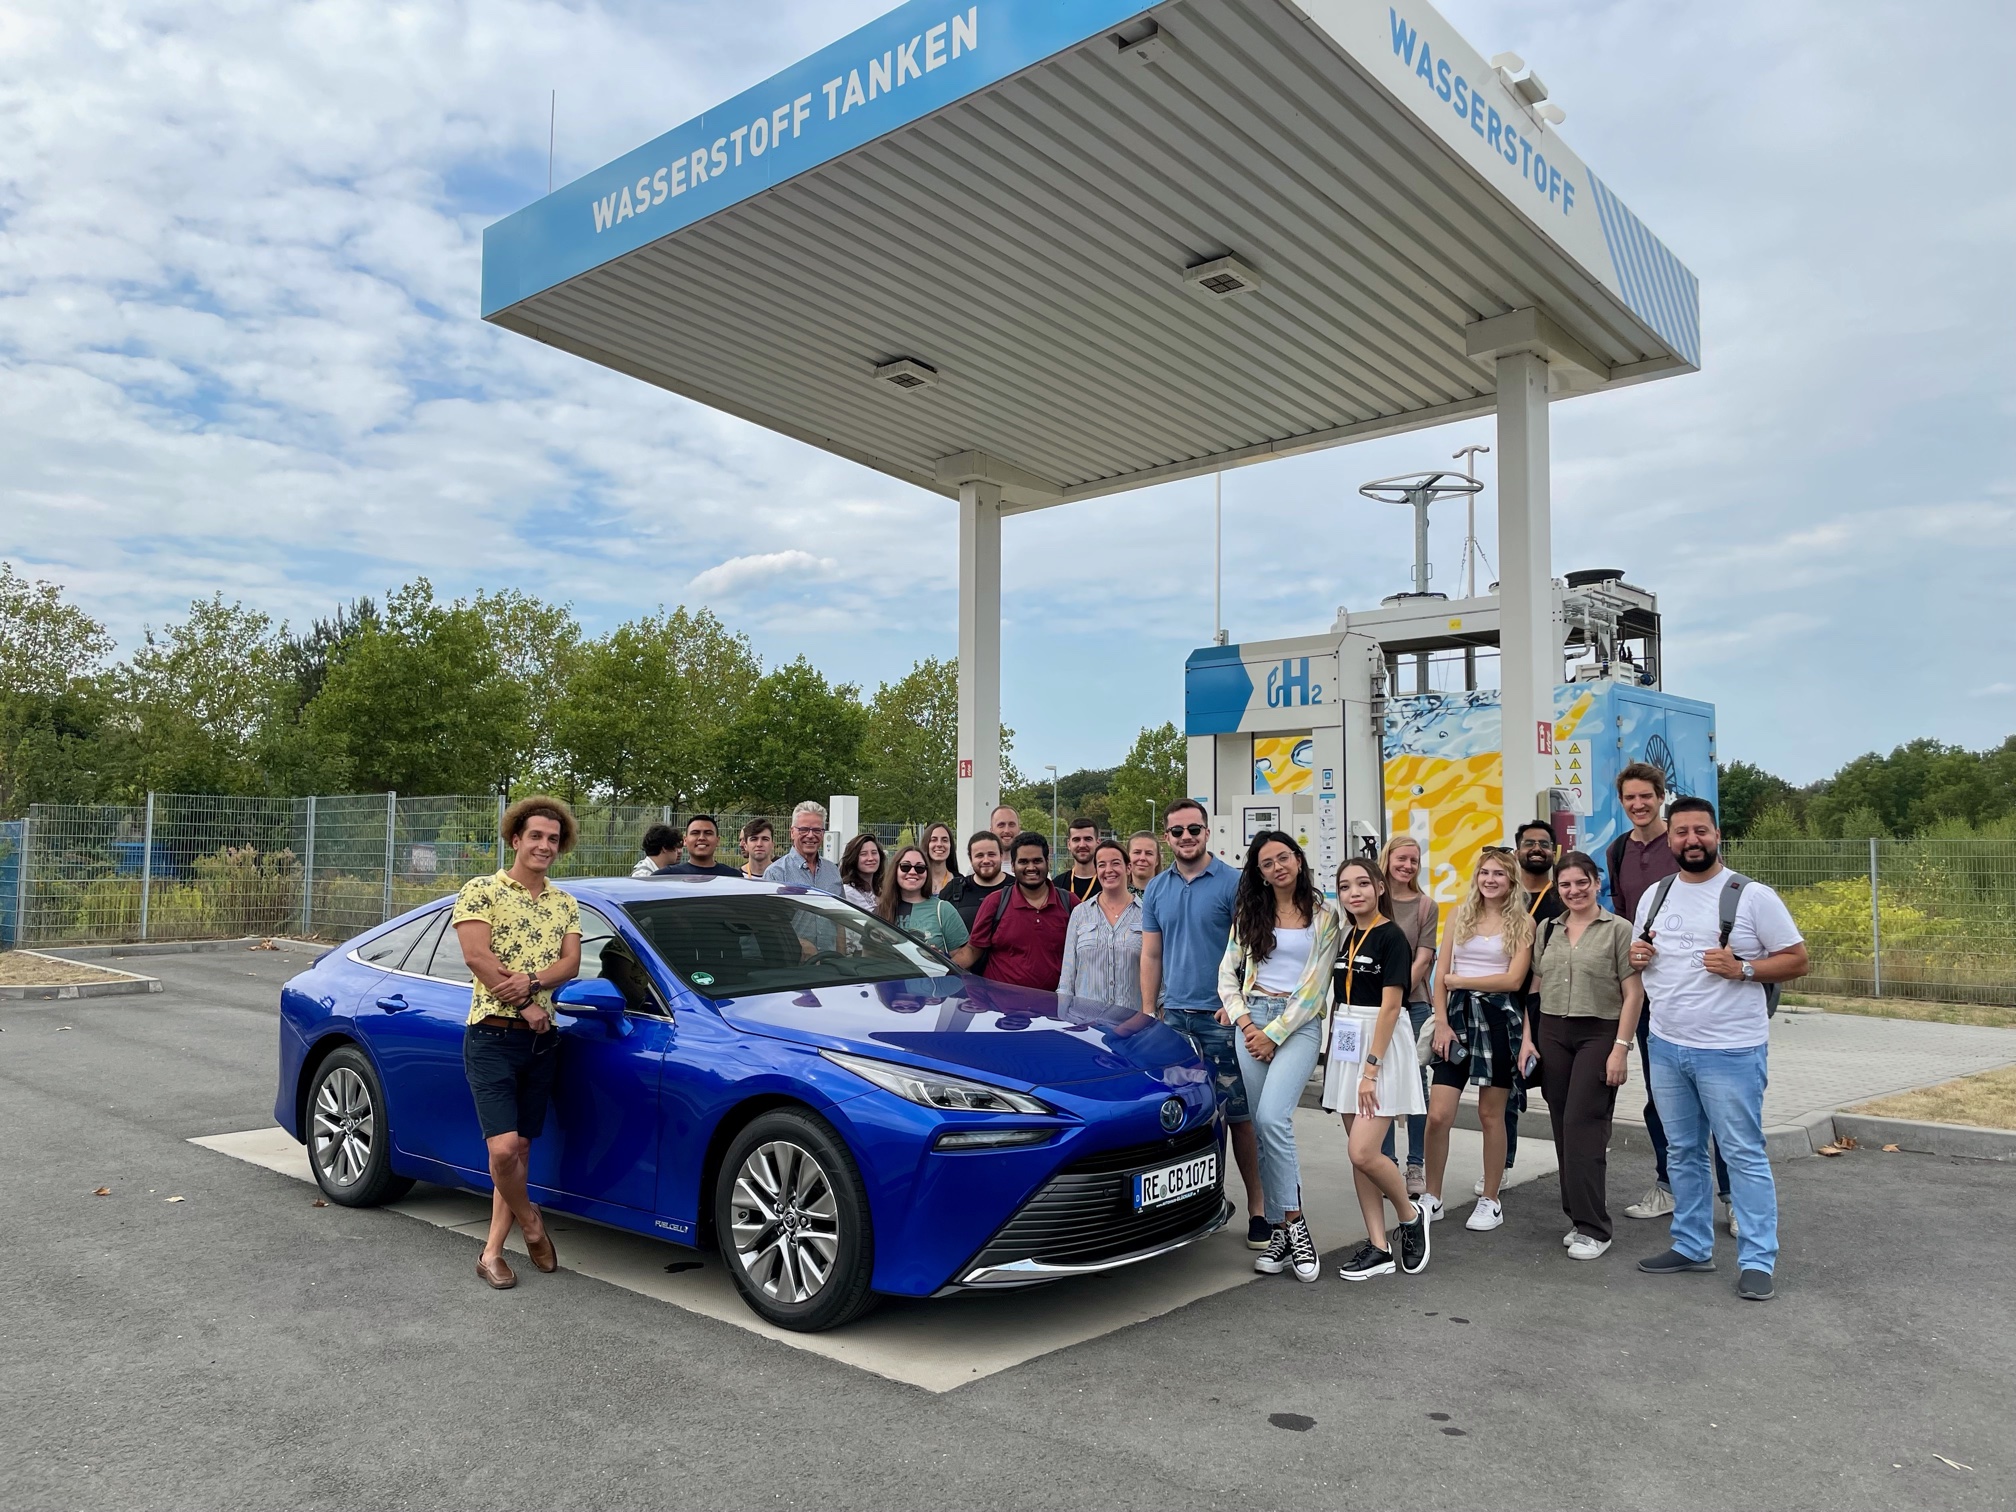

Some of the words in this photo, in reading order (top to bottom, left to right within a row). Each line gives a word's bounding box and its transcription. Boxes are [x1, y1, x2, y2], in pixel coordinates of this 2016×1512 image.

[592, 92, 812, 234] WASSERSTOFF
[822, 5, 978, 121] TANKEN
[1389, 6, 1575, 216] WASSERSTOFF
[1143, 1175, 1159, 1202] RE
